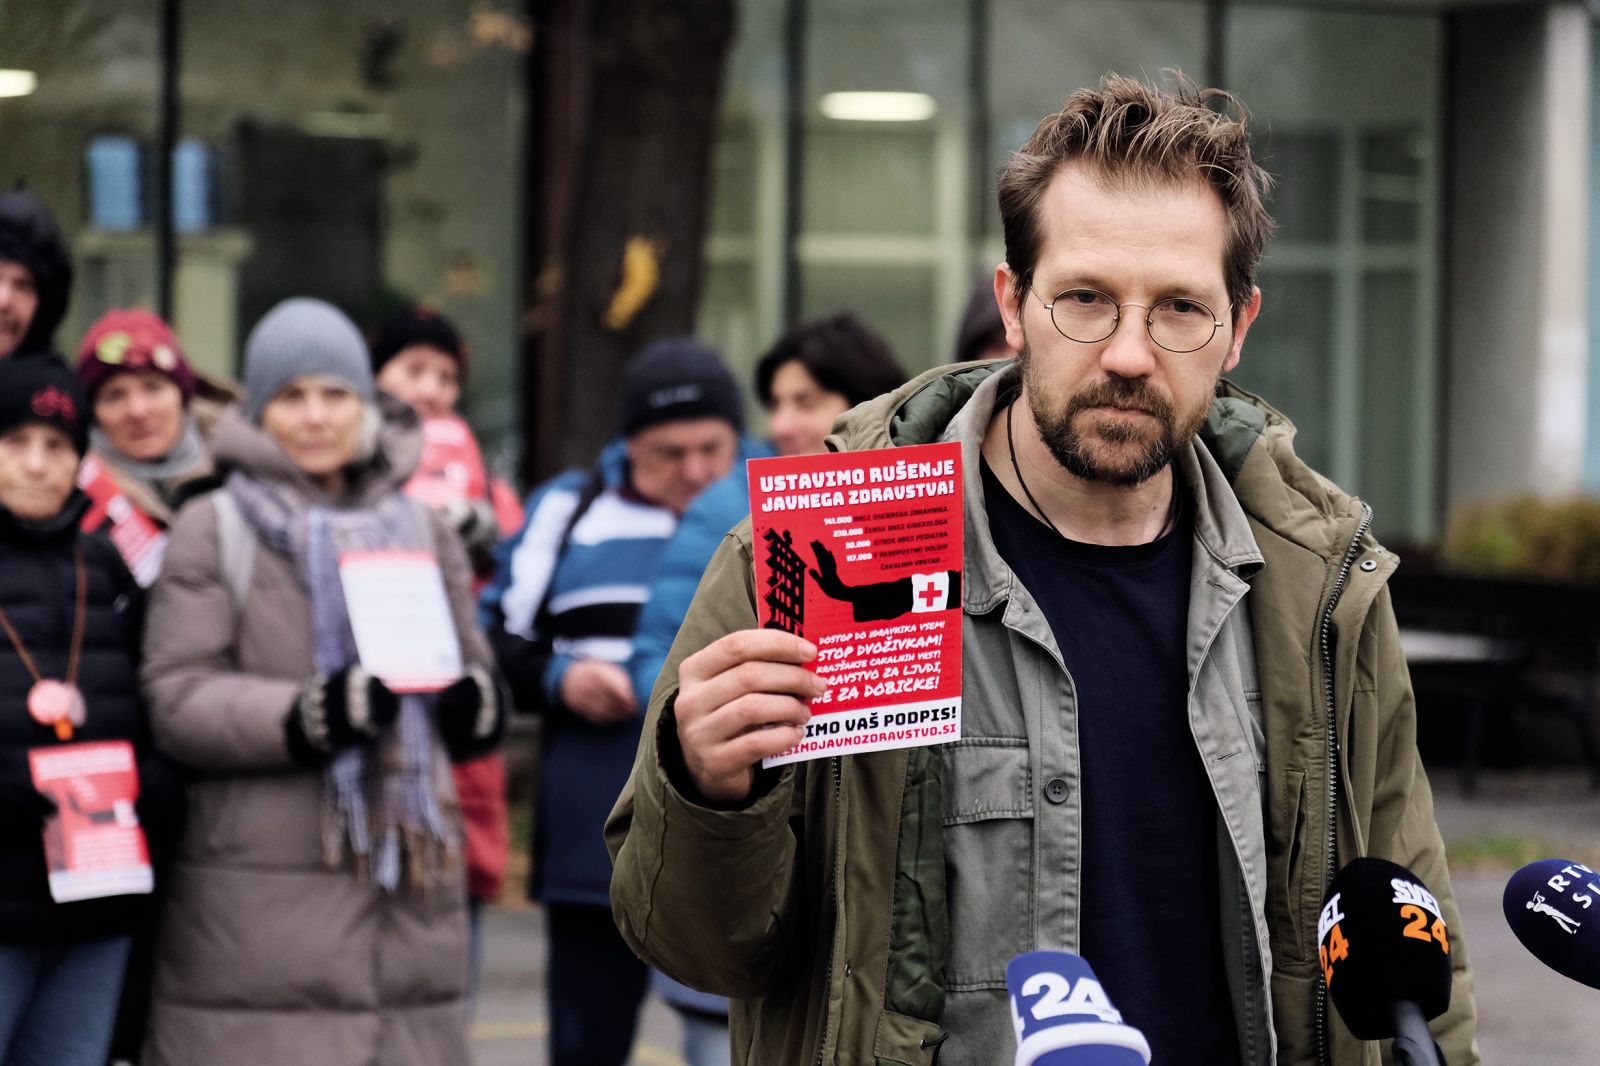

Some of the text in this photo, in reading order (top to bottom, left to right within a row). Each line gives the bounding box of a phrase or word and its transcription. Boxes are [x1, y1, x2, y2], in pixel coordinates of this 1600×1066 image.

[760, 459, 955, 493] USTAVIMO RUŠENJE
[761, 480, 955, 512] JAVNEGA ZDRAVSTVA!
[909, 506, 949, 516] ZDRAVNIKA
[817, 634, 943, 662] STOP DVOŽIVKAM!
[818, 632, 853, 645] DOSTOP
[854, 630, 867, 640] DO
[868, 624, 917, 638] ZDRAVNIKA
[883, 667, 900, 679] ZA
[837, 687, 860, 702] ZA
[864, 676, 940, 698] DOBIČKE!
[845, 712, 879, 731] VAŠ
[884, 706, 957, 727] PODPIS!
[1547, 864, 1593, 892] RTV
[1400, 904, 1450, 955] 24
